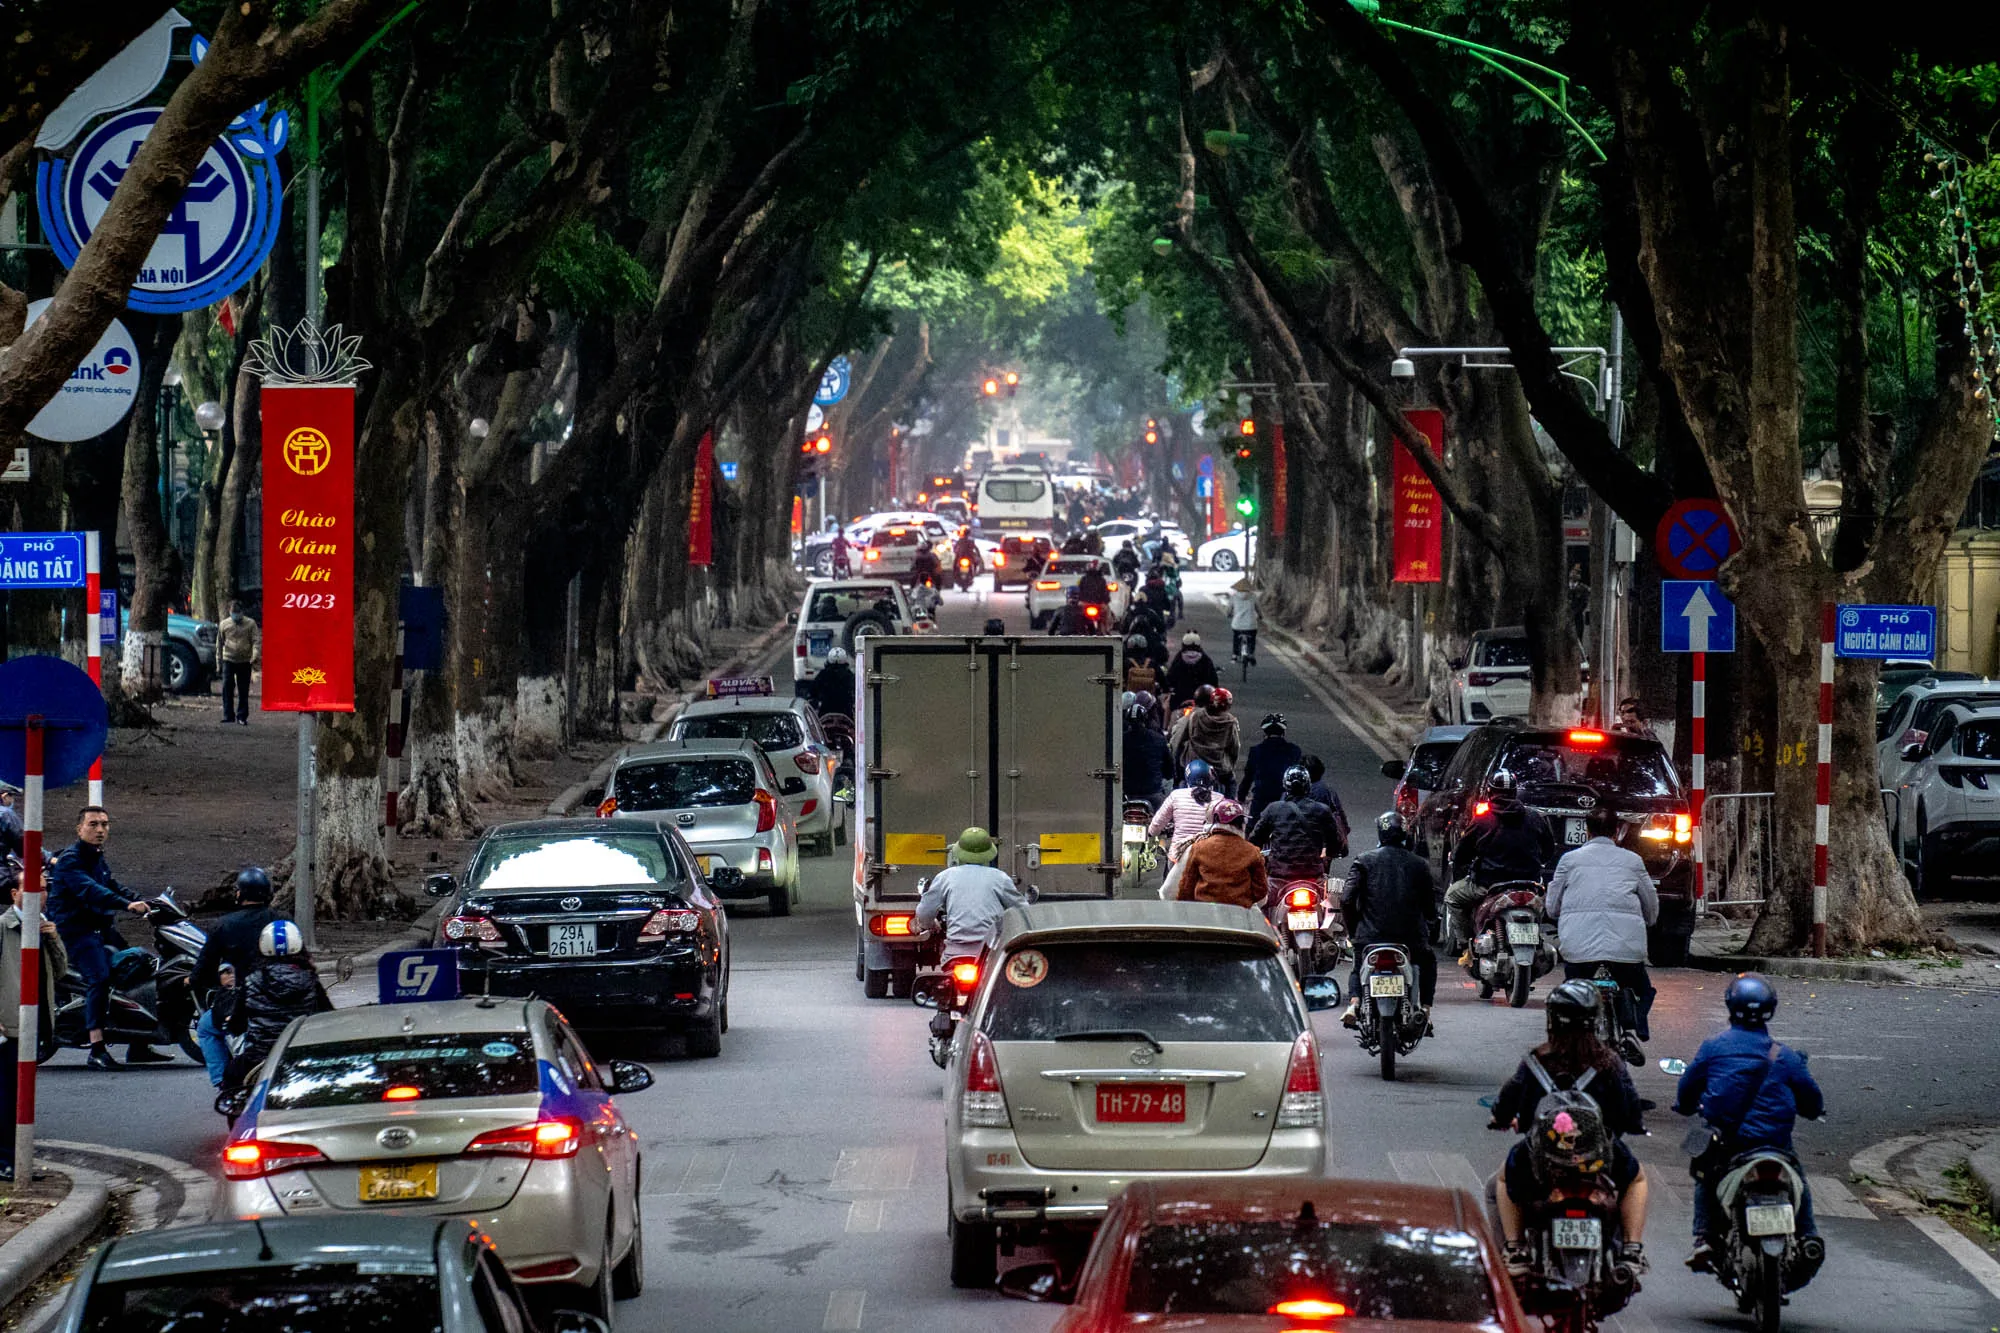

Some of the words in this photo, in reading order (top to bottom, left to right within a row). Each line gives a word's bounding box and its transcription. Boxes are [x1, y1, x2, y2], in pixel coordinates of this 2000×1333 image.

[161, 267, 184, 286] NỘI
[70, 363, 105, 381] ank
[281, 509, 335, 527] Chào
[1404, 519, 1432, 529] 2023
[24, 538, 56, 552] PHỐ
[280, 537, 336, 555] Năm
[0, 557, 39, 582] ẶNG
[44, 555, 73, 579] TẤT
[285, 564, 330, 582] Mới
[282, 593, 335, 610] 2023
[1880, 611, 1910, 624] PHỐ
[1844, 627, 1877, 650] NGUYỄN
[1879, 627, 1902, 651] CẢNH
[1903, 630, 1927, 651] CHÂN
[560, 926, 585, 940] 29A
[551, 942, 593, 956] 261.14
[1100, 1093, 1182, 1114] TH-79-48
